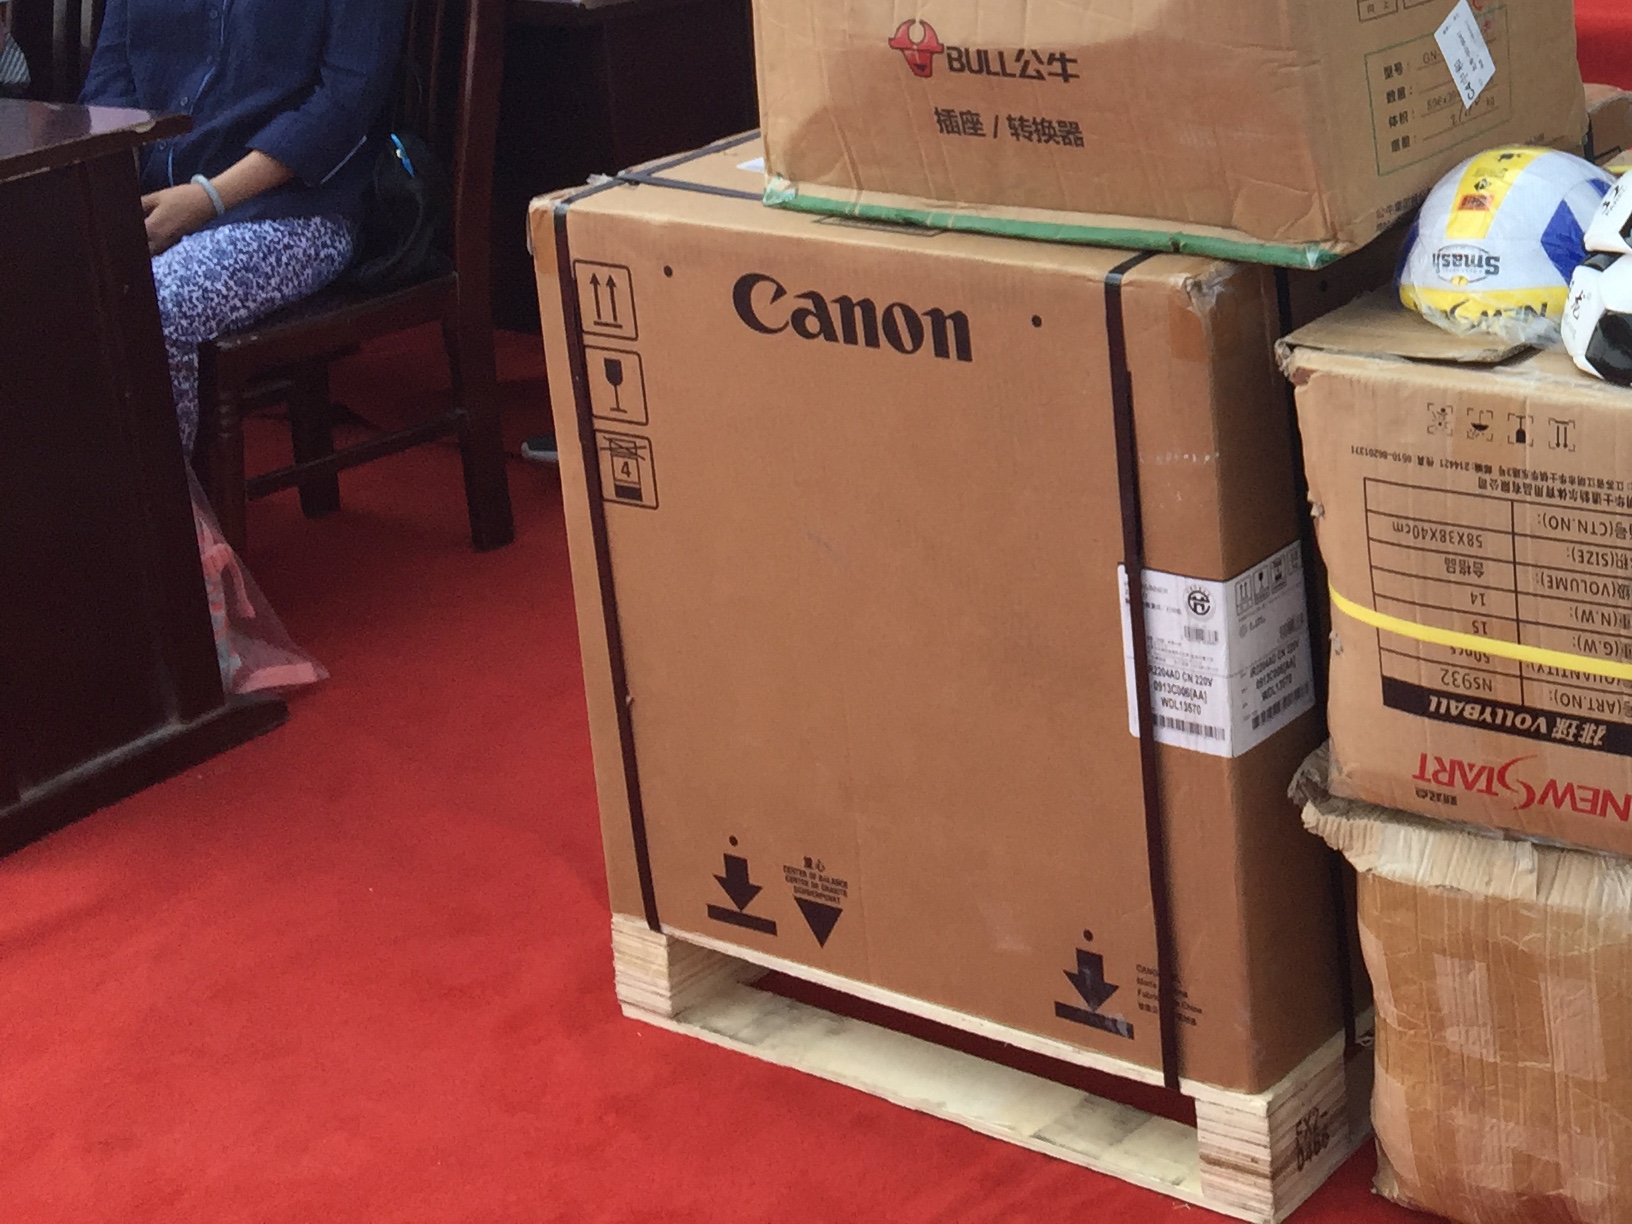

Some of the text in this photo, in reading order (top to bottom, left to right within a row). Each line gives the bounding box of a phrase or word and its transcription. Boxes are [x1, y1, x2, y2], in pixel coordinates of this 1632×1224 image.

[934, 107, 986, 137] 插座
[1006, 114, 1085, 147] 转换器
[1433, 253, 1500, 275] Smash
[732, 272, 973, 363] Canon
[621, 461, 631, 478] 4
[1392, 521, 1483, 548] 58X38X40cm
[1470, 592, 1486, 606] 14
[1472, 620, 1488, 634] 15
[1195, 674, 1213, 687] 220V
[1440, 668, 1493, 692] NS932
[1428, 695, 1607, 746] 排球 VOLLYBALL
